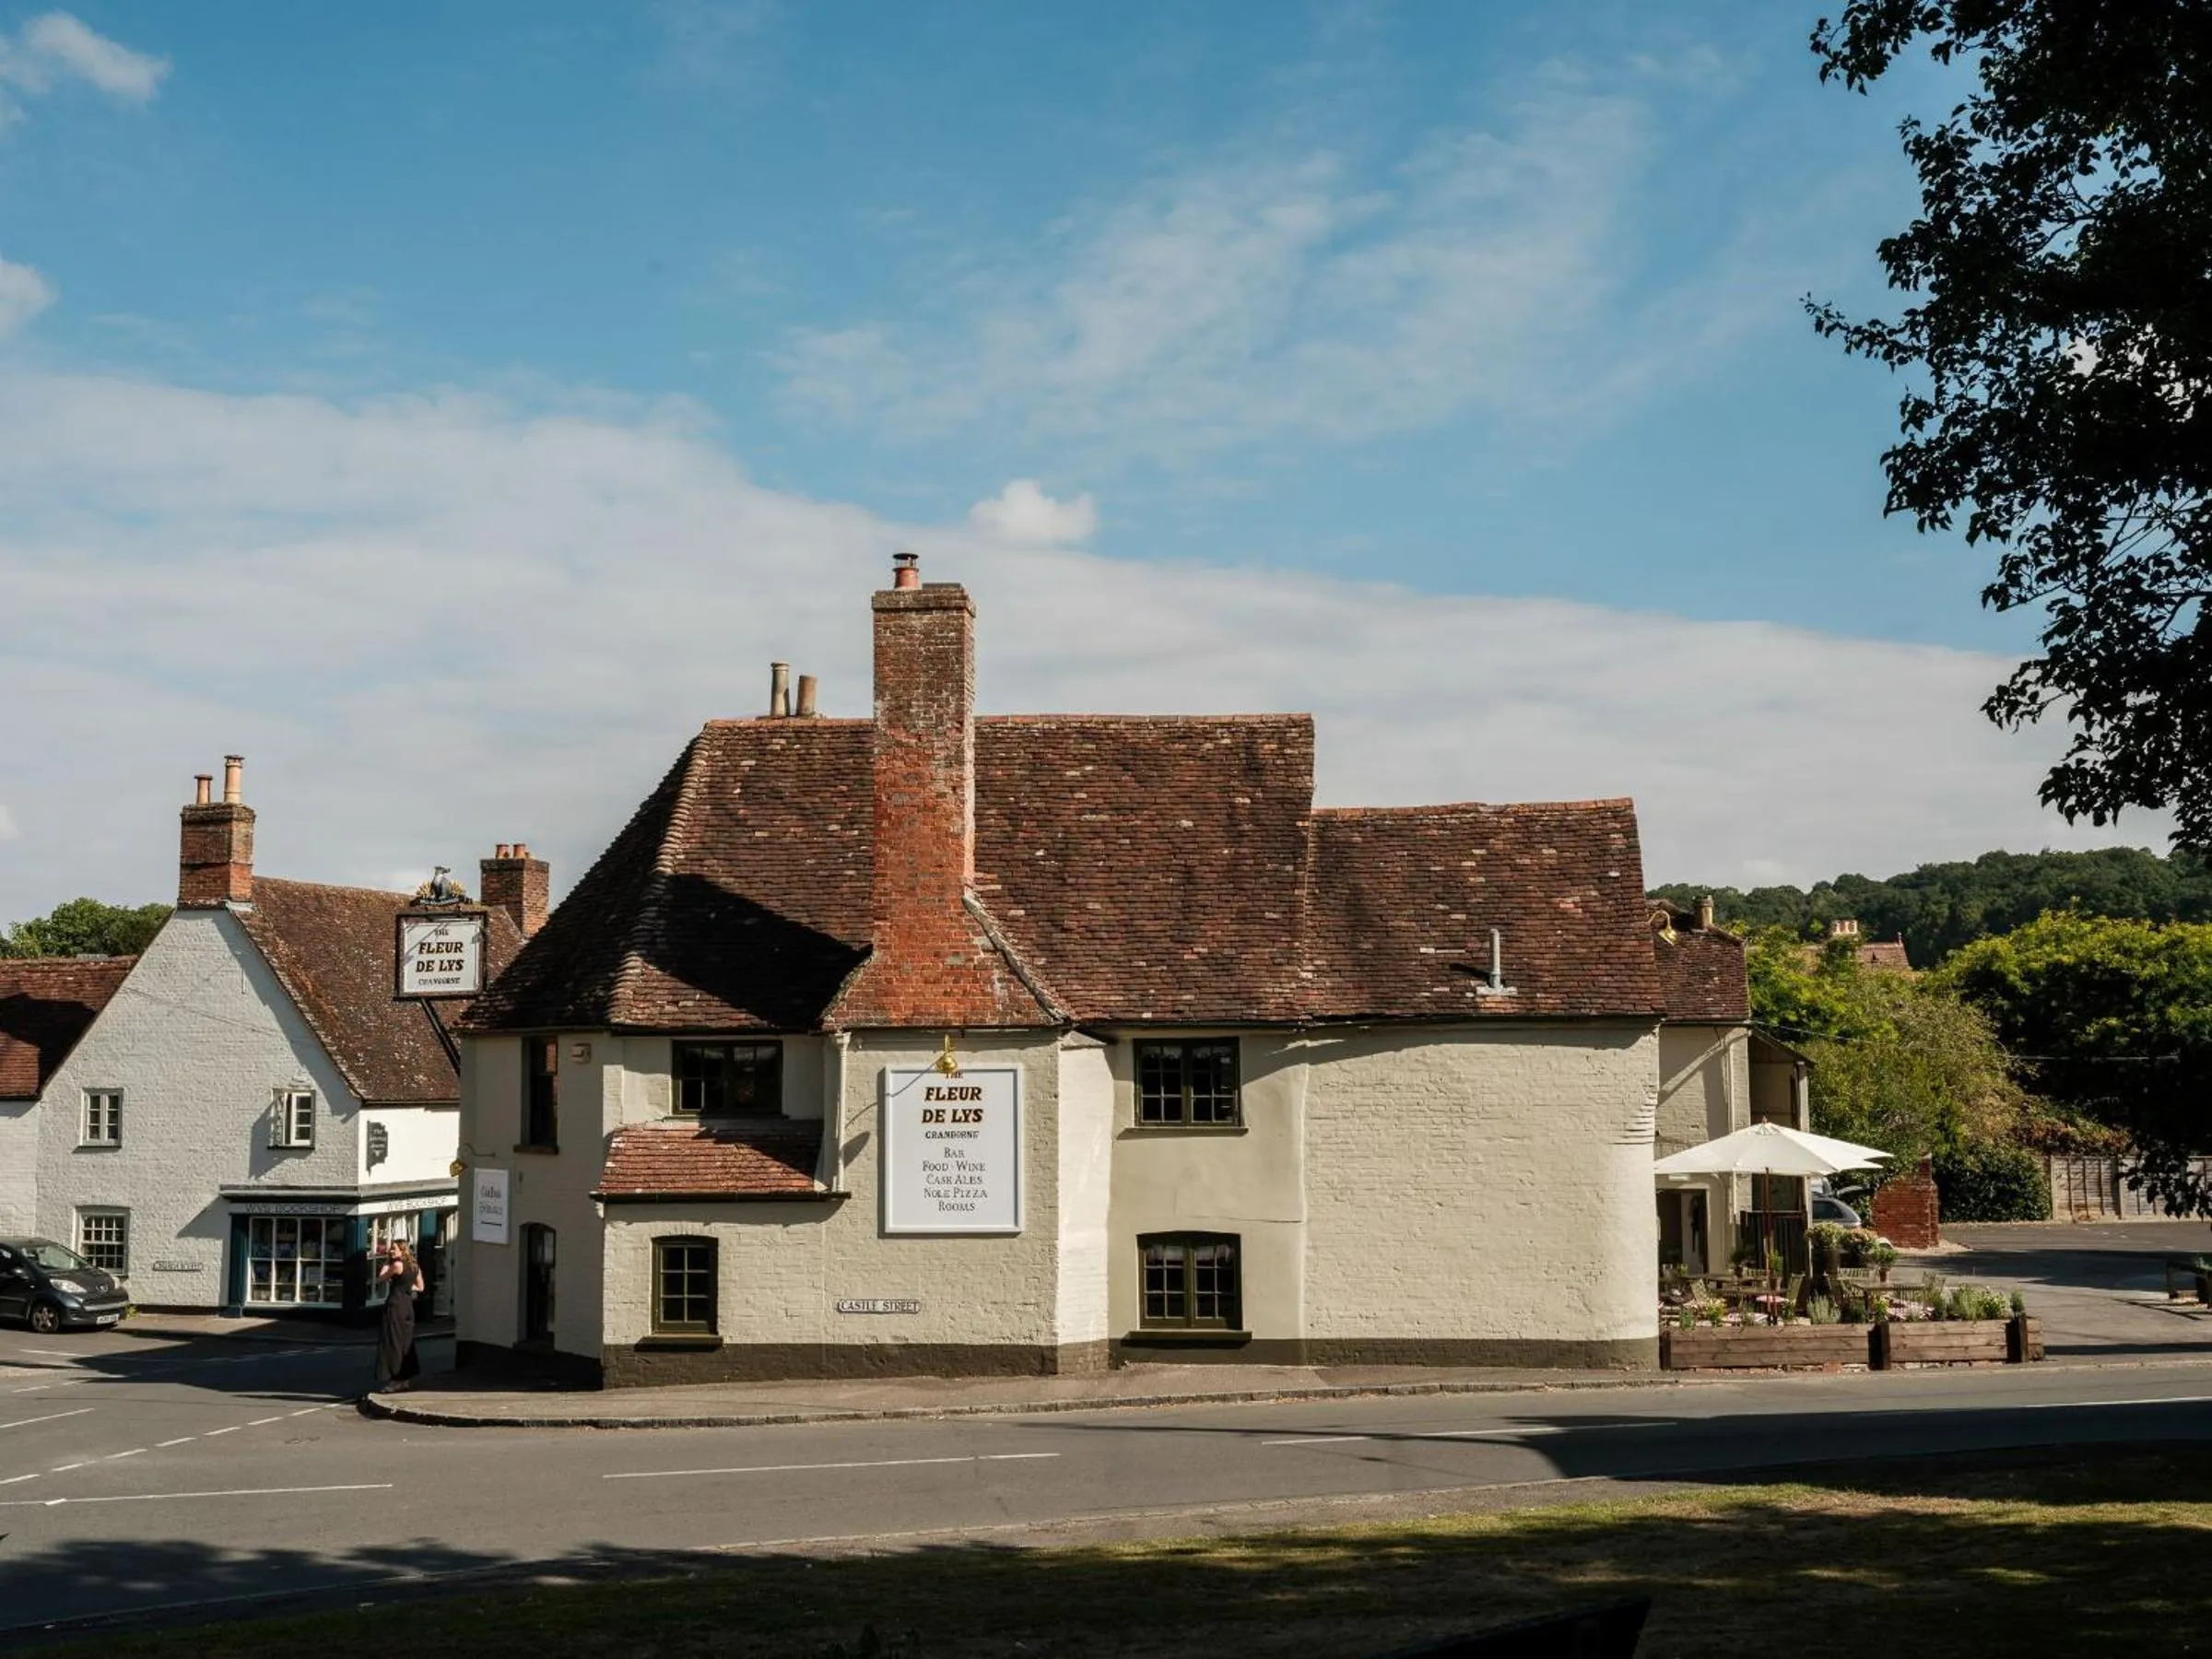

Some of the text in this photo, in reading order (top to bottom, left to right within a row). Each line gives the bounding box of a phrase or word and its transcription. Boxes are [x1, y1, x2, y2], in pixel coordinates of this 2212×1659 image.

[418, 942, 463, 954] FLEUR
[416, 959, 464, 972] DE LYS
[924, 1087, 982, 1101] FLEUR
[922, 1108, 983, 1124] DE LYS
[924, 1130, 979, 1140] CRANBORNE
[944, 1147, 965, 1159] BAR
[922, 1160, 985, 1172] FOOD WINE
[925, 1172, 982, 1185] CASK ALES
[953, 1186, 987, 1199] PIZZA
[938, 1200, 975, 1213] ROOMS
[882, 1300, 917, 1311] STREET
